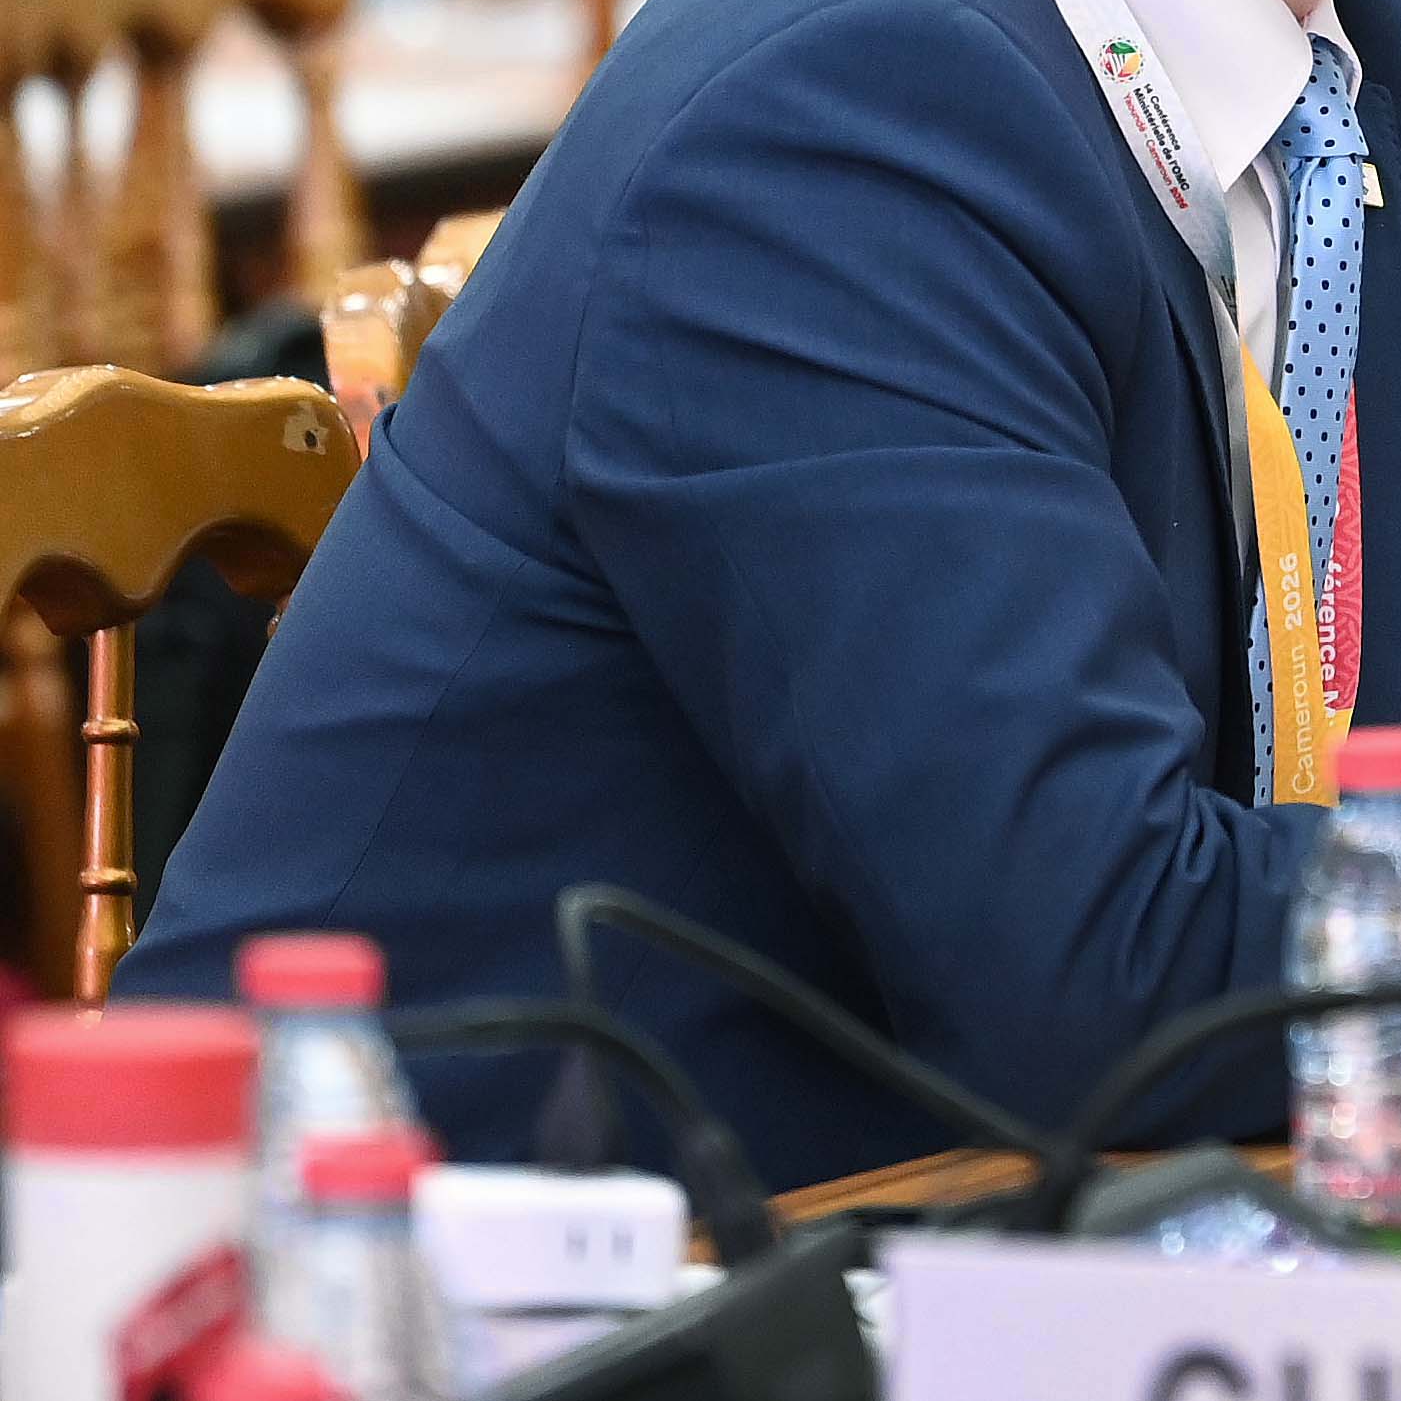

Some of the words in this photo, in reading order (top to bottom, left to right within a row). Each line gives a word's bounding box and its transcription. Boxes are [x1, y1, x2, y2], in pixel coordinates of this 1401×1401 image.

[1132, 87, 1166, 147] Ministérielle
[1161, 147, 1173, 161] de
[1168, 159, 1190, 192] l'OMC
[1143, 83, 1154, 95] 14
[1150, 95, 1182, 151] Conférence
[1146, 138, 1173, 185] Cameroun
[1169, 186, 1189, 210] 2026
[1281, 551, 1304, 631] 2026
[1291, 644, 1315, 795] Cameroun
